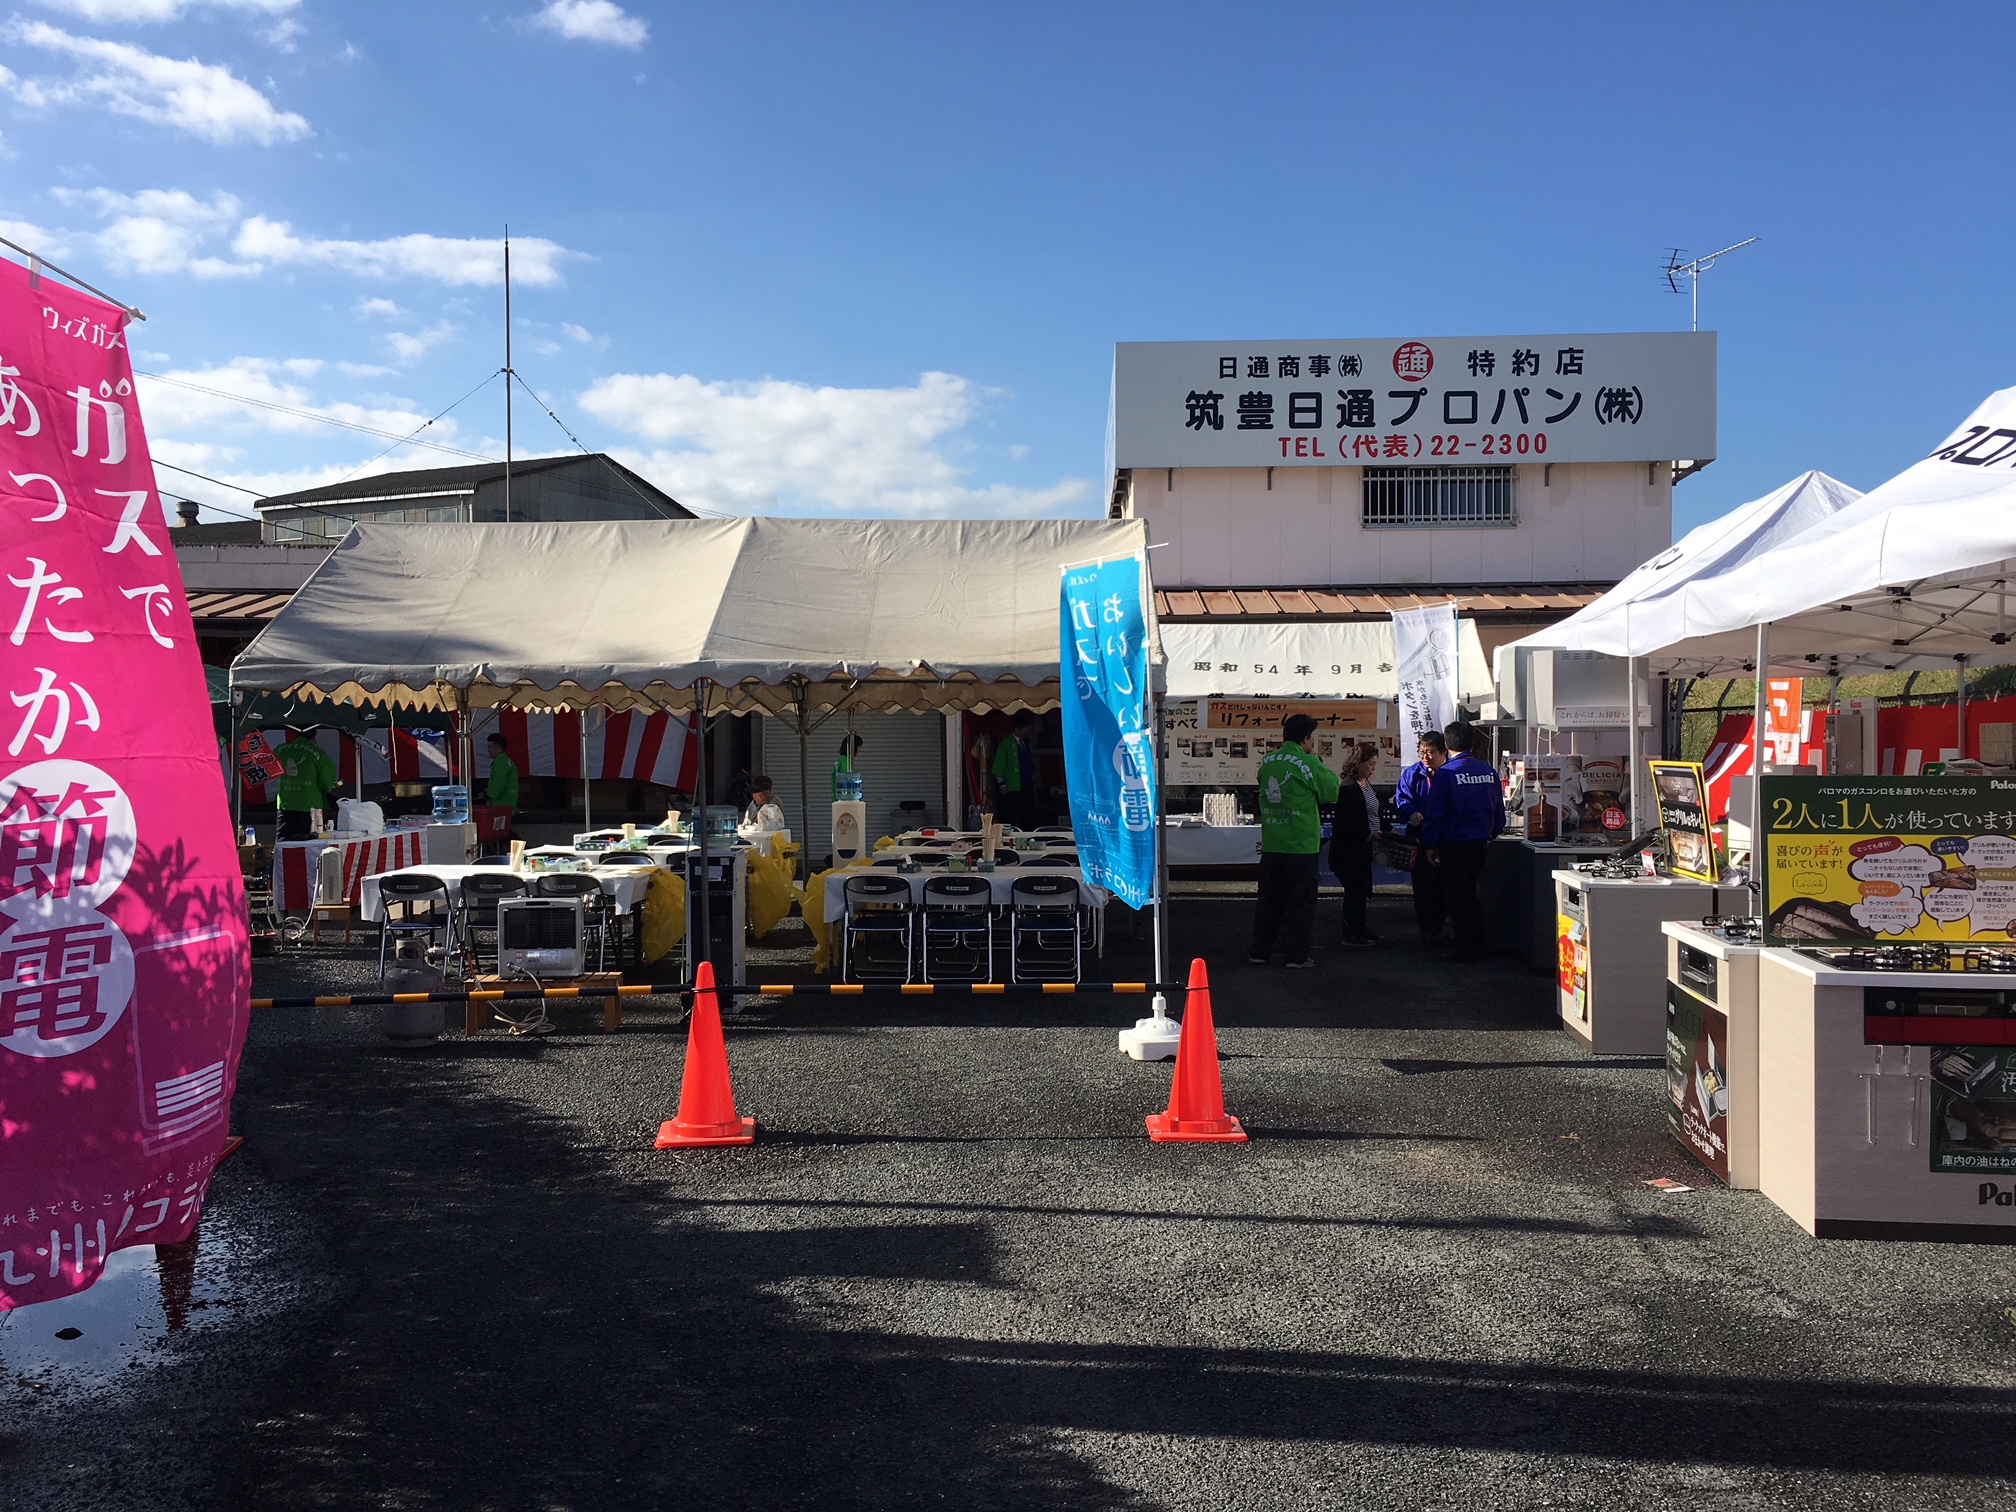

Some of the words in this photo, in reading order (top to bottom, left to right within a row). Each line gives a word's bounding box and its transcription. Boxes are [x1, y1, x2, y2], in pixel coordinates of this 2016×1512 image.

[43, 305, 126, 350] ウィズガス
[1467, 347, 1585, 377] 特約店
[1184, 385, 1643, 432] 筑豊日通プロパン(株)
[1278, 436, 1325, 458] TEL
[67, 379, 175, 649] ガスで
[1456, 773, 1494, 786] Rinnai
[1818, 787, 1977, 796] パロマのガスコンロをお選びいただいた方の
[1776, 841, 1843, 859] 喜びの声が
[1776, 859, 1843, 869] 届いています!
